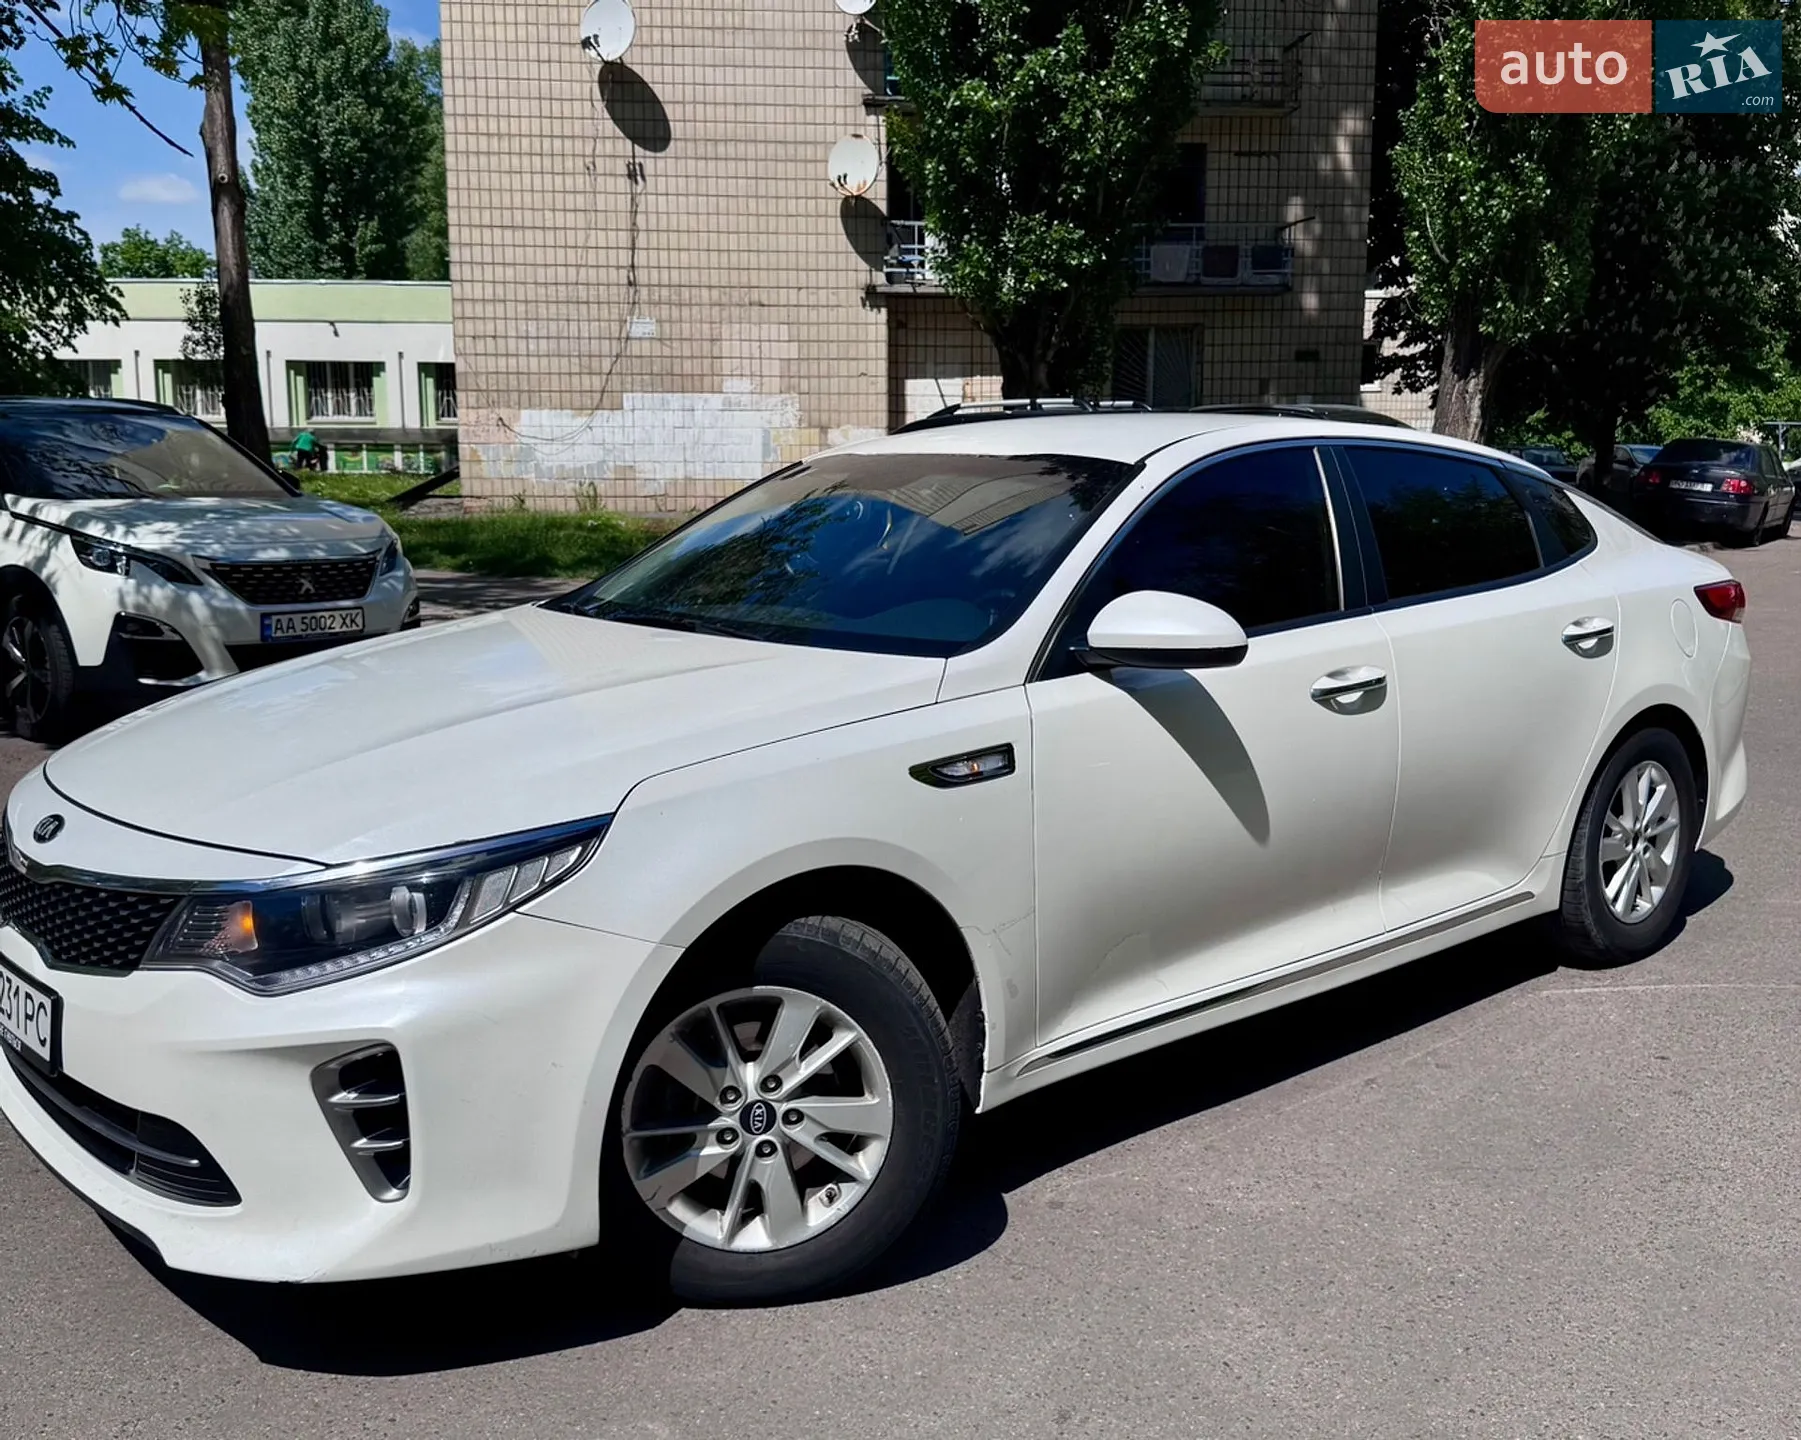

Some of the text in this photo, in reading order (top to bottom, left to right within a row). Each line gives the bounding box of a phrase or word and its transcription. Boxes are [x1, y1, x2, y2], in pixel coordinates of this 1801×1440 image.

[273, 611, 360, 635] AA 5002 XK
[24, 990, 48, 1048] PC
